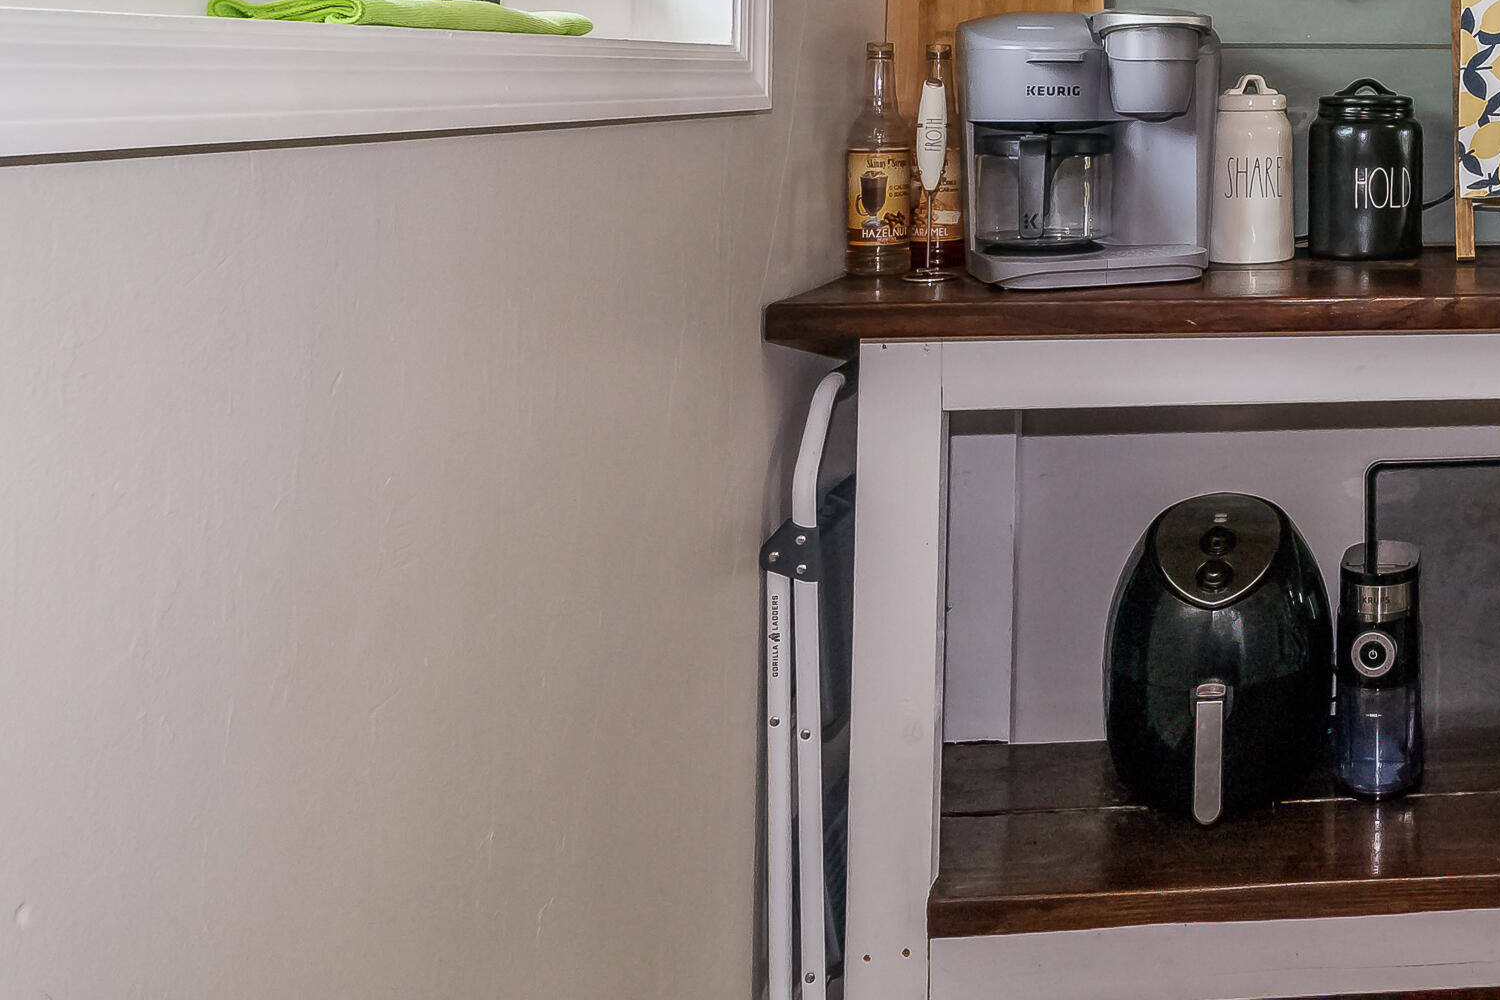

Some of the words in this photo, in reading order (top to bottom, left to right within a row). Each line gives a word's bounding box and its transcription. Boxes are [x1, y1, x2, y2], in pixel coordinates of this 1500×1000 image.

[1026, 85, 1081, 97] KEURIG
[924, 118, 943, 152] FROTH
[1224, 156, 1283, 199] SHARE
[1354, 166, 1412, 209] HOLD
[771, 595, 779, 631] LADDERS
[1362, 595, 1391, 604] KRUS
[771, 644, 779, 678] GORILLA
